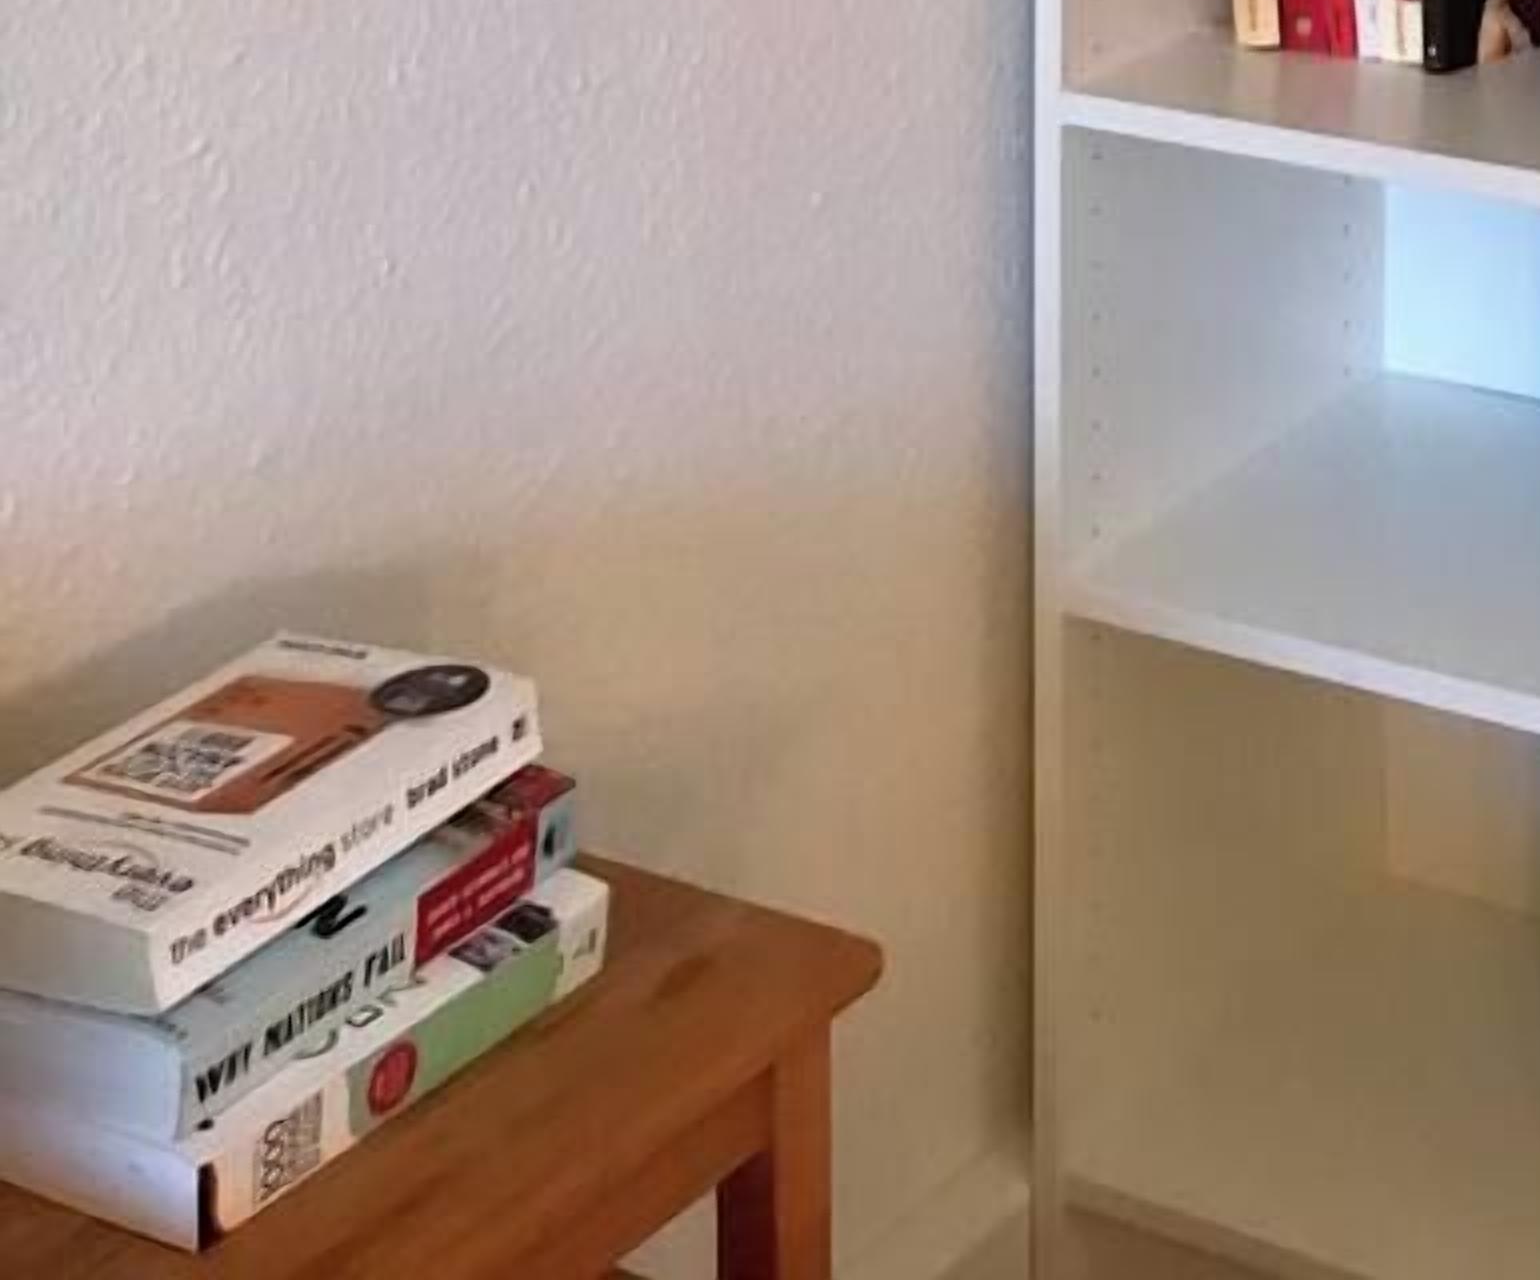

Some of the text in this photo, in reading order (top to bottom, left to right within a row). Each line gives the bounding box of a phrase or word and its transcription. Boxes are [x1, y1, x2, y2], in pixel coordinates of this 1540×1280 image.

[169, 735, 499, 965] the everything store brad stone
[195, 932, 405, 1104] WHY NATIONS FAIL
